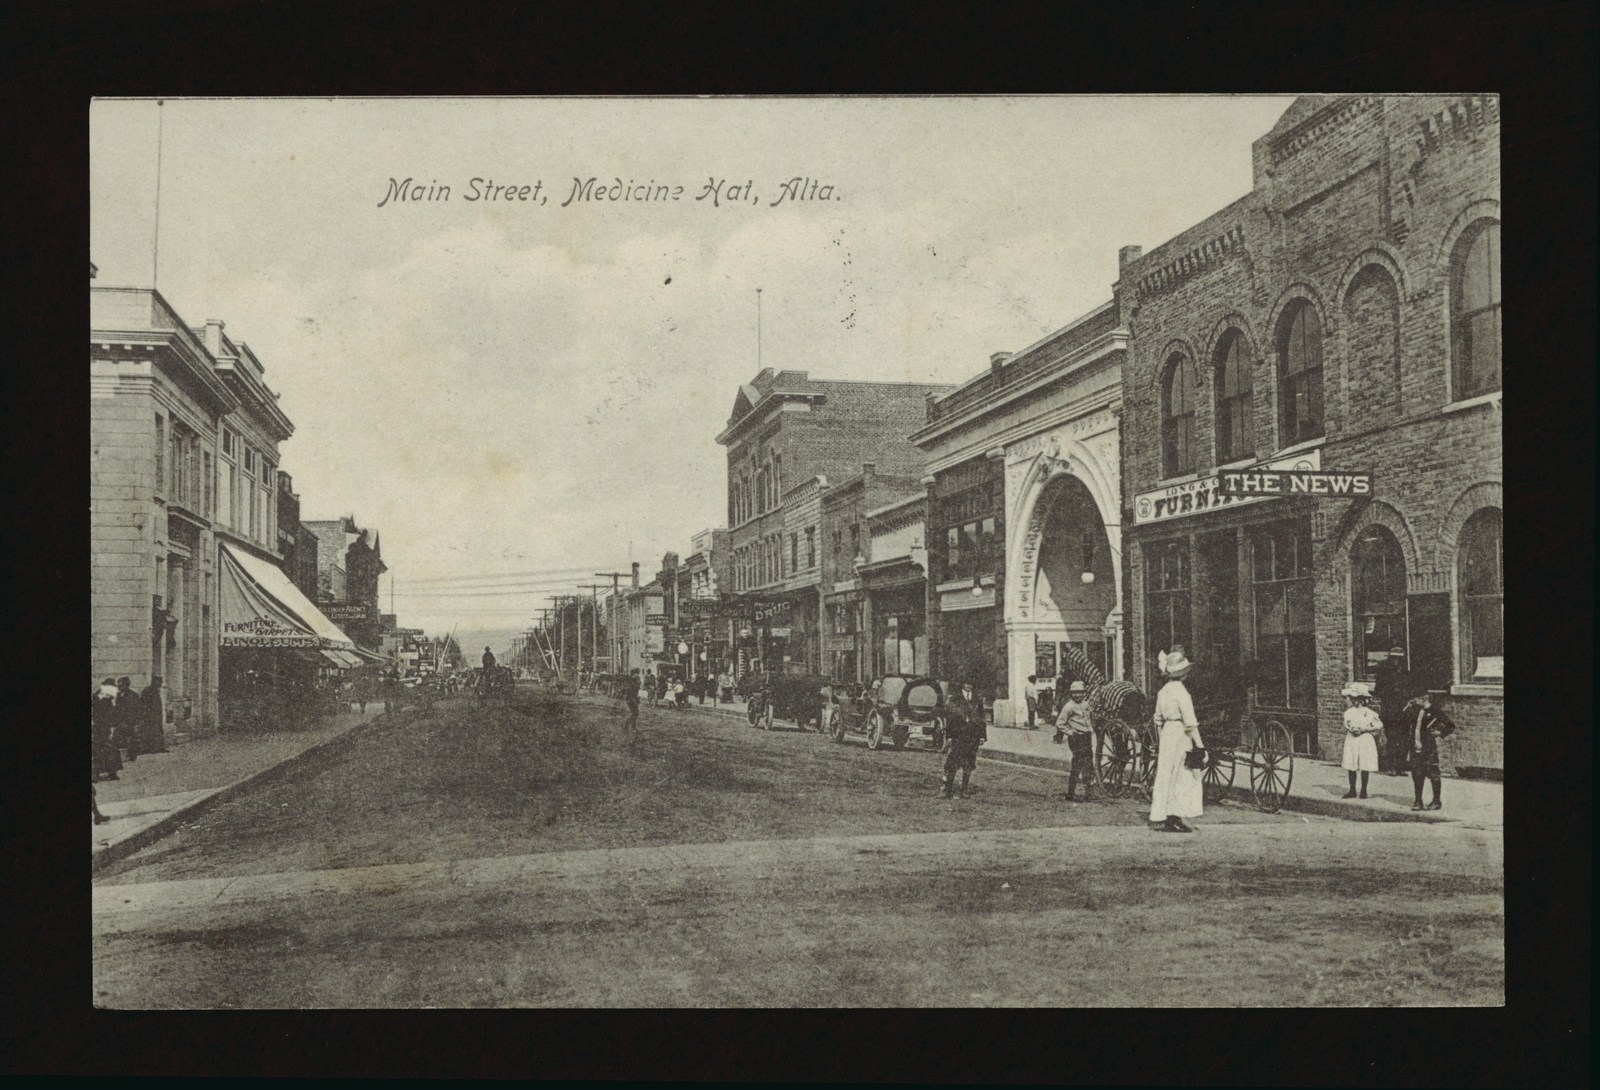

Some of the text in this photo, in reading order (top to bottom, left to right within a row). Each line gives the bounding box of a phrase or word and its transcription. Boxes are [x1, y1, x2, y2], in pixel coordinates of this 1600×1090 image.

[1166, 485, 1195, 497] LONG
[1199, 481, 1208, 489] &
[1224, 474, 1280, 493] THE
[1290, 475, 1369, 493] NEWS
[755, 601, 791, 620] DRUG
